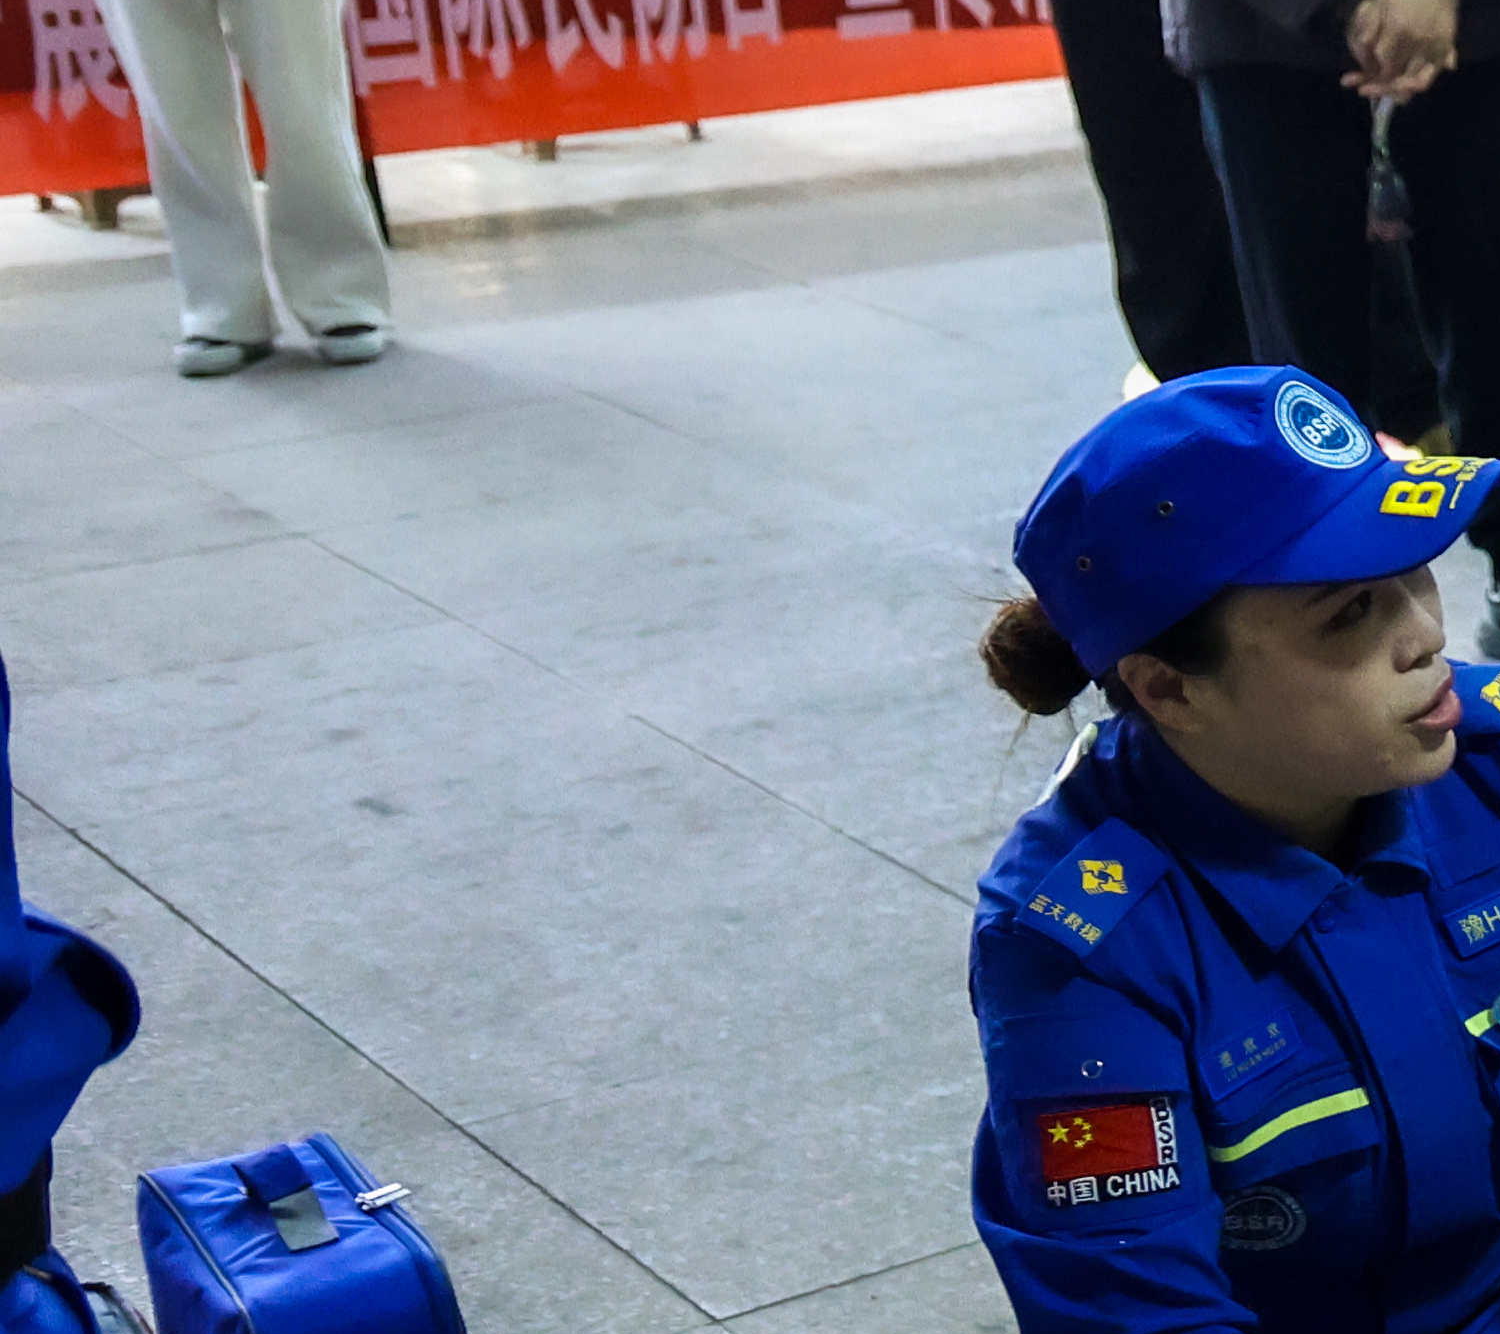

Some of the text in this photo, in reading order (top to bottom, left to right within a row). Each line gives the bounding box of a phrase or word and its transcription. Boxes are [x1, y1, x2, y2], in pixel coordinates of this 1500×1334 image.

[1301, 411, 1342, 447] BSR
[1379, 455, 1466, 519] BS
[1046, 1166, 1181, 1207] 中国 CHINA
